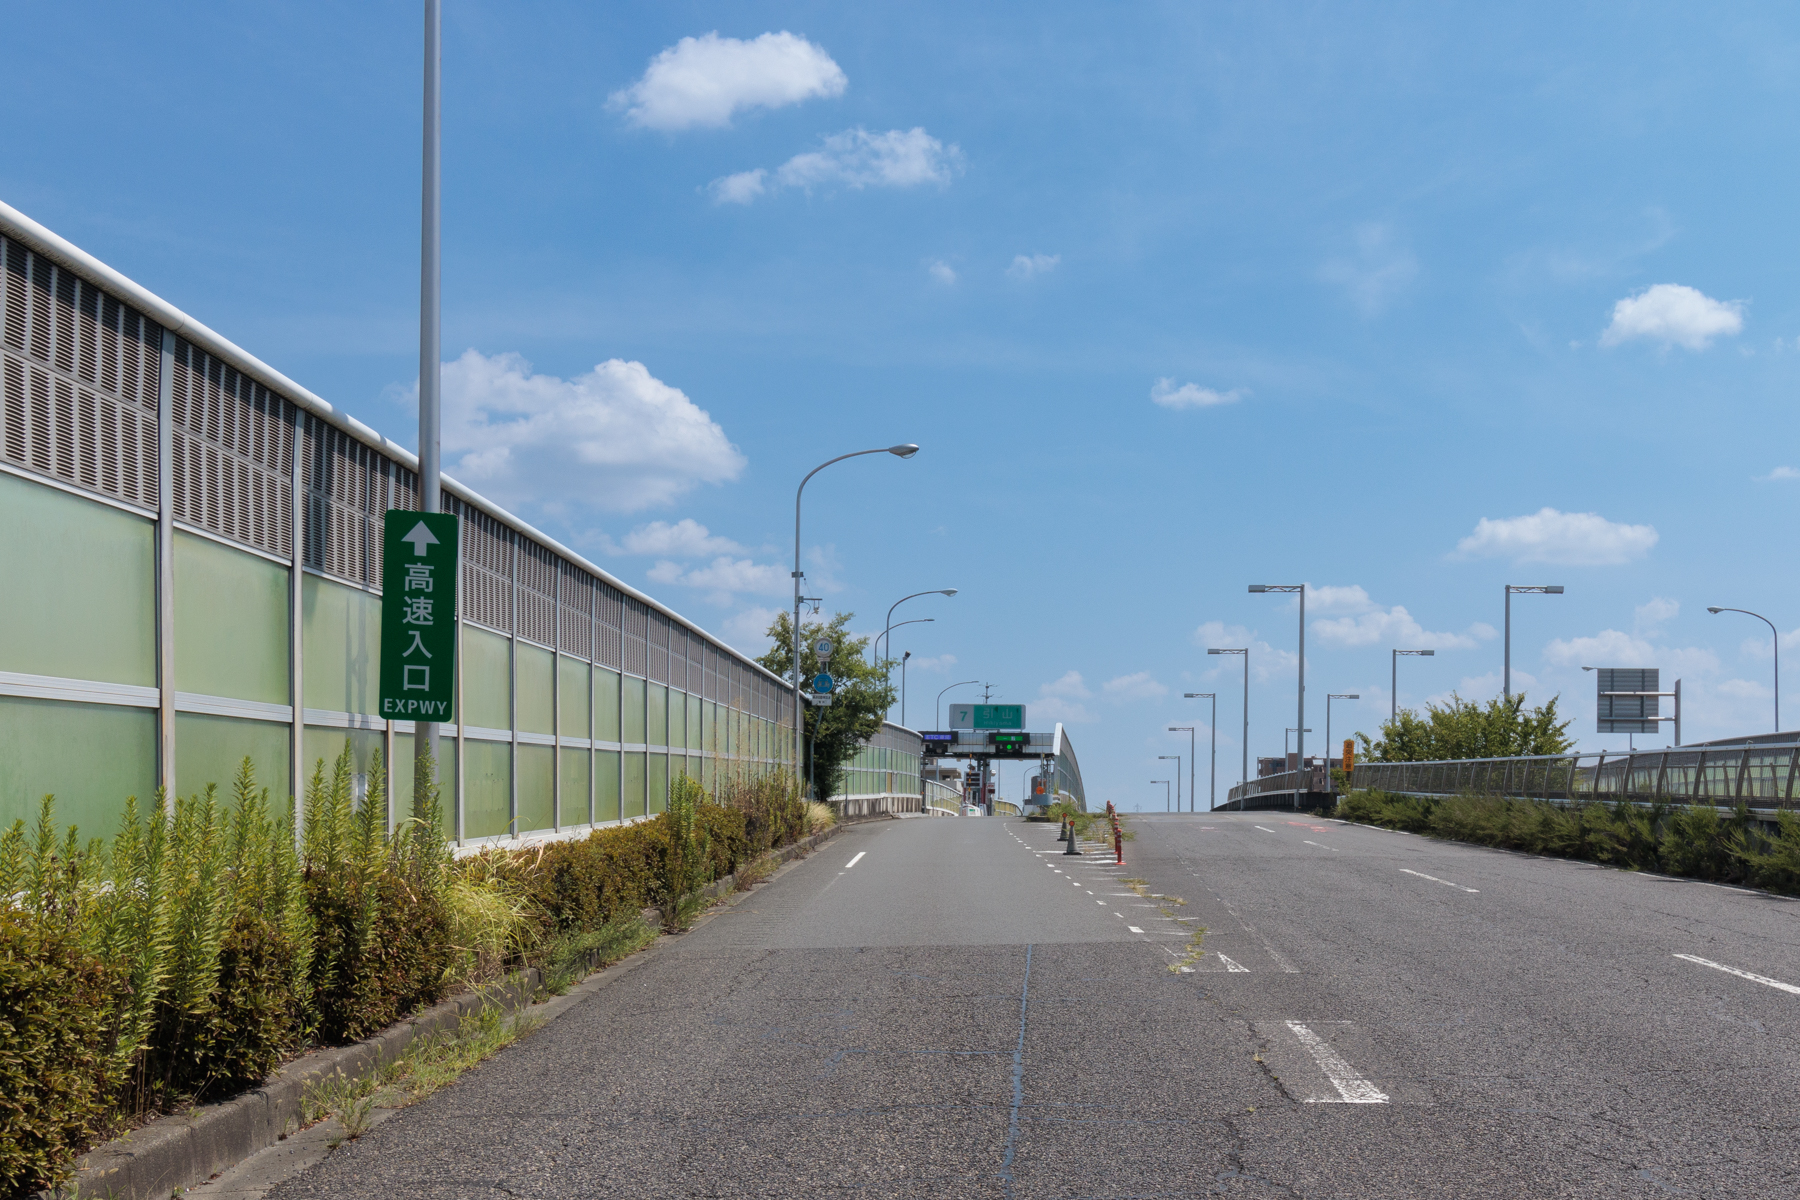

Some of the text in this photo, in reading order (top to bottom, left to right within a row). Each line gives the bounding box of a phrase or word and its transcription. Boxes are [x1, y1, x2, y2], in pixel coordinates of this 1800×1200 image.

[402, 562, 435, 692] 高速入口
[818, 642, 830, 651] 40
[383, 698, 448, 715] EXPWY
[960, 711, 968, 722] 7
